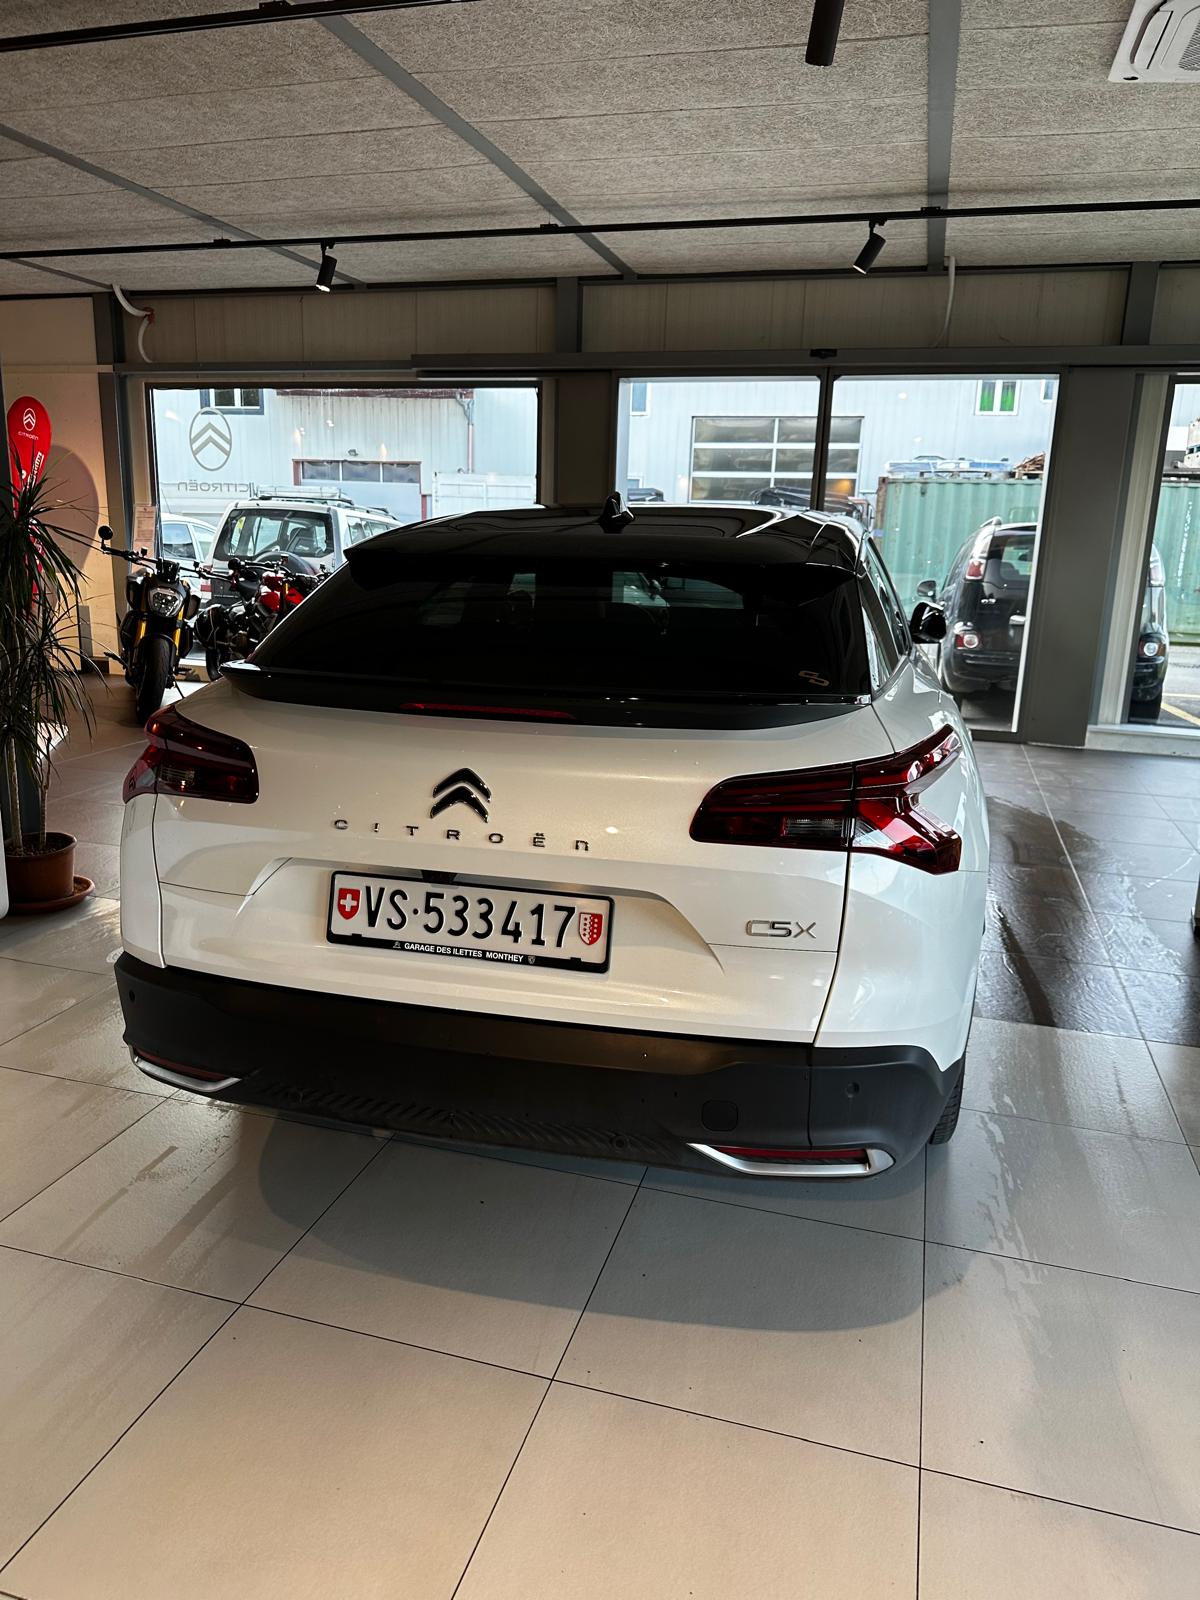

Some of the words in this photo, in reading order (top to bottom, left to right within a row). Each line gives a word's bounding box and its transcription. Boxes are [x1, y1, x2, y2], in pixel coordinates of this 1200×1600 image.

[745, 919, 817, 939] C5X
[404, 942, 435, 953] GARAGE
[436, 946, 452, 955] DES
[452, 949, 483, 958] ILETTES
[485, 951, 524, 963] MONTHEY
